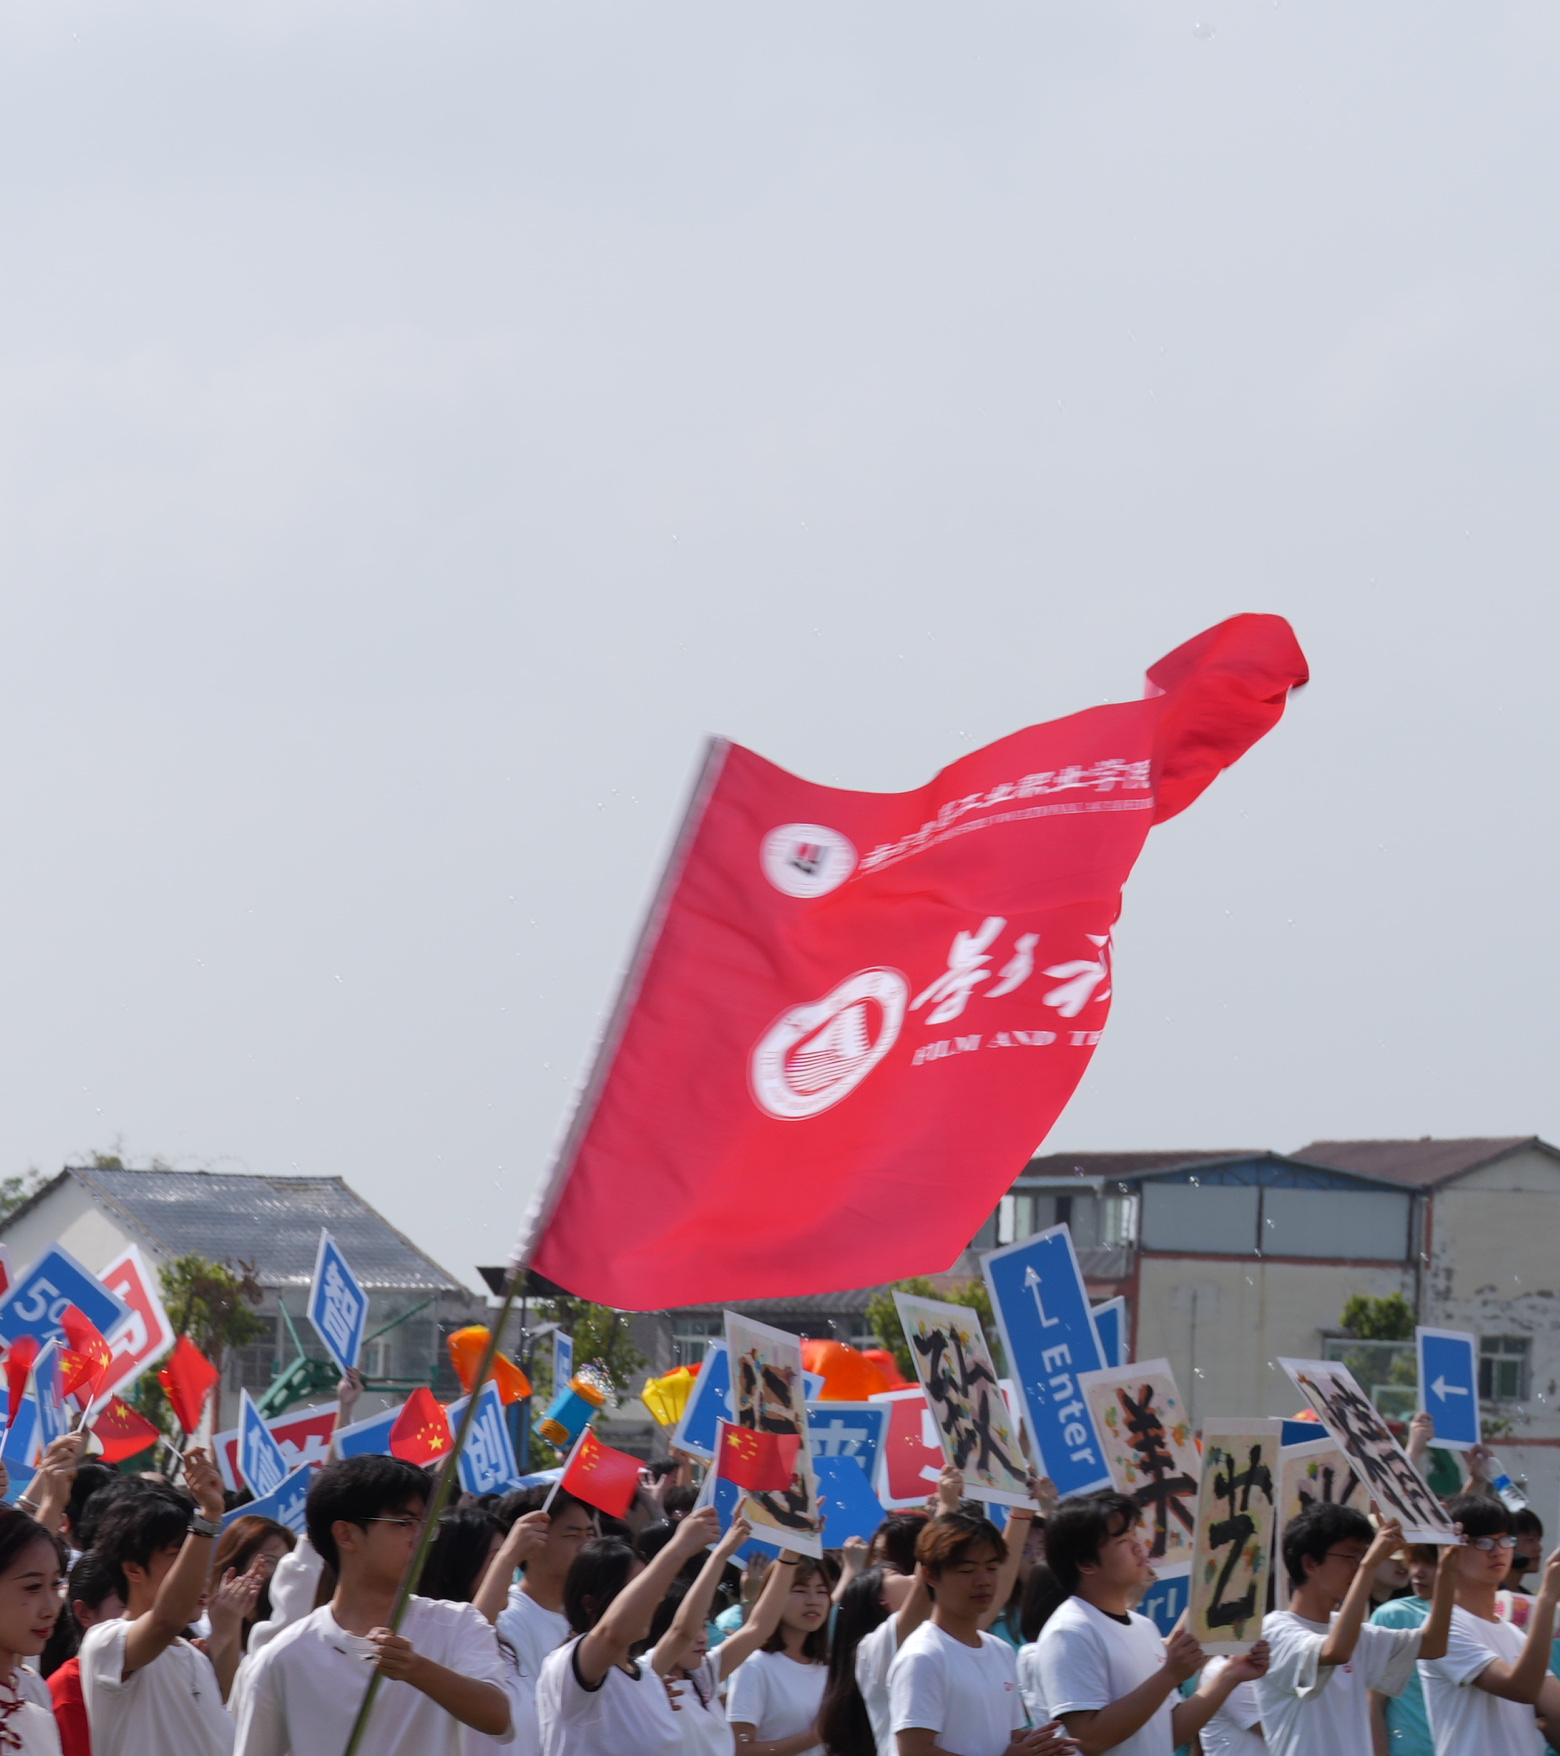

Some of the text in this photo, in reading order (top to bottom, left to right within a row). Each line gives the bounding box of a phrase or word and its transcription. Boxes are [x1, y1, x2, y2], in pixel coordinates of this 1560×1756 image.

[911, 1034, 984, 1066] FILM
[986, 1029, 1058, 1048] AND
[323, 1260, 360, 1355] 智
[462, 1402, 510, 1493] 创
[1041, 1343, 1097, 1466] Enter
[1206, 1445, 1273, 1629] 艺
